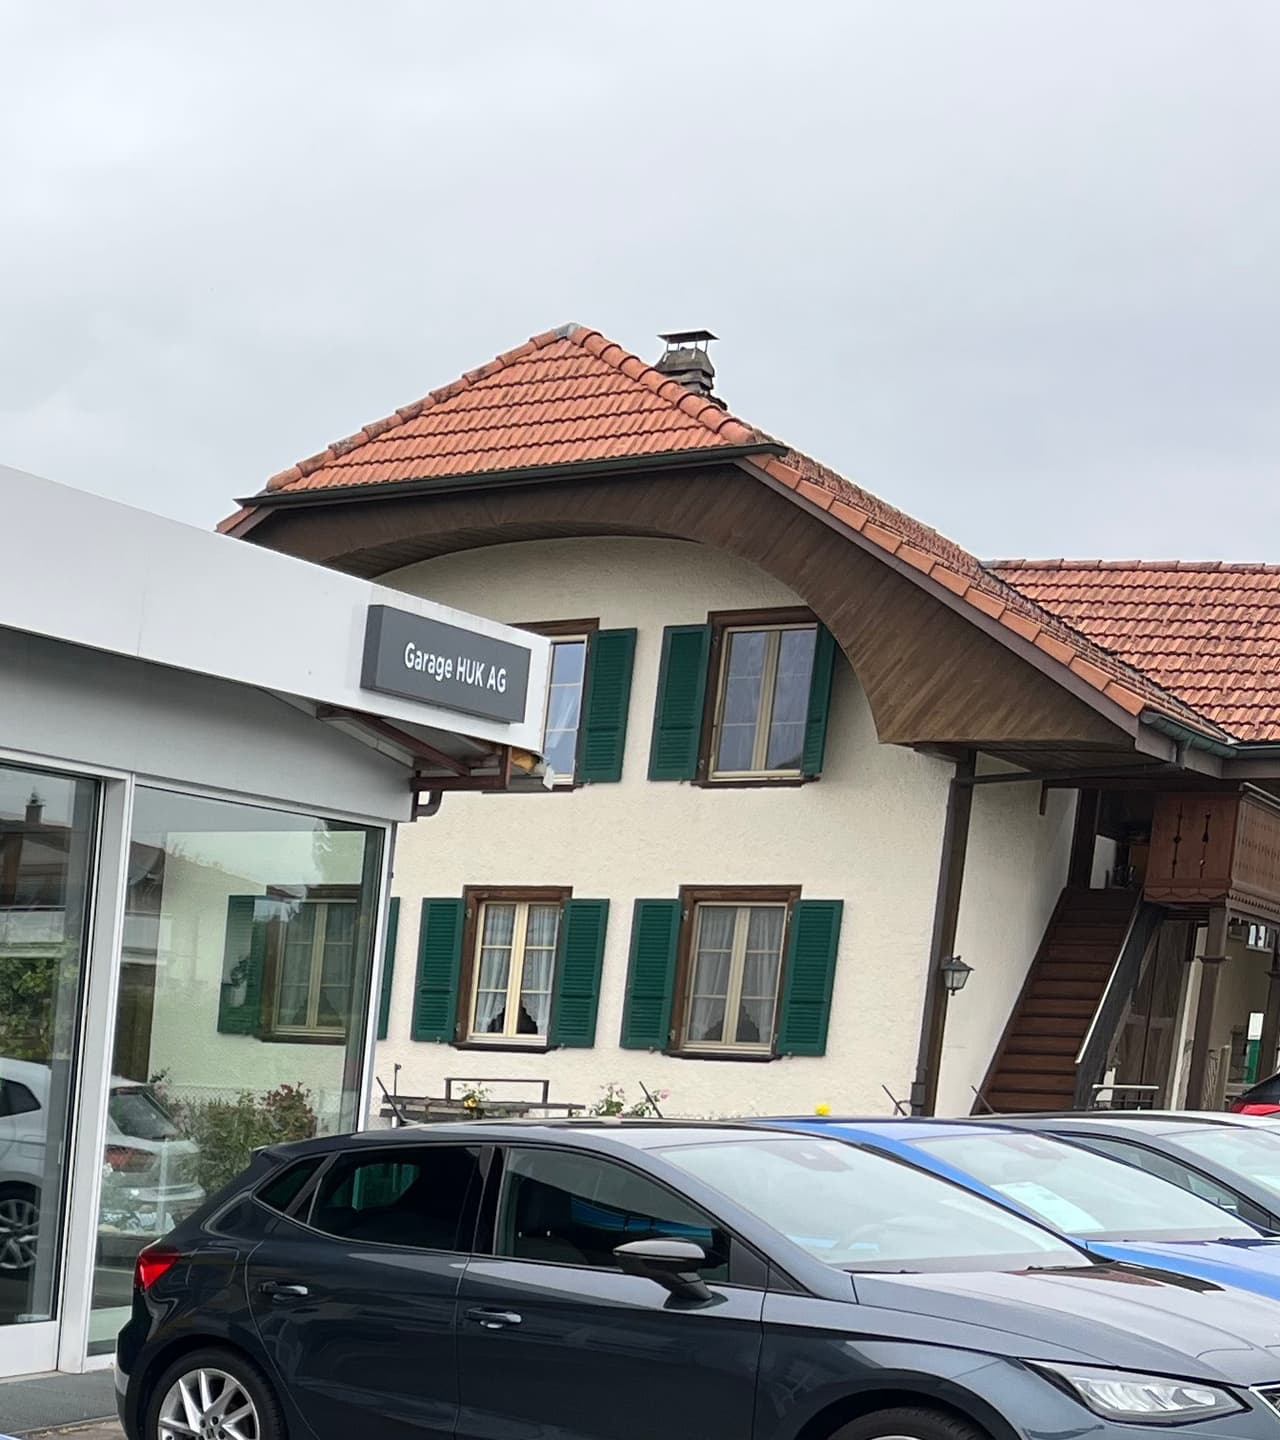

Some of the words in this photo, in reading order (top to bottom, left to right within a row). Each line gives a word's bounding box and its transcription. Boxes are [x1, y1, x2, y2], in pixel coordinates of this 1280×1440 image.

[404, 641, 453, 682] Garage
[456, 656, 485, 688] HUK
[487, 665, 507, 694] AG
